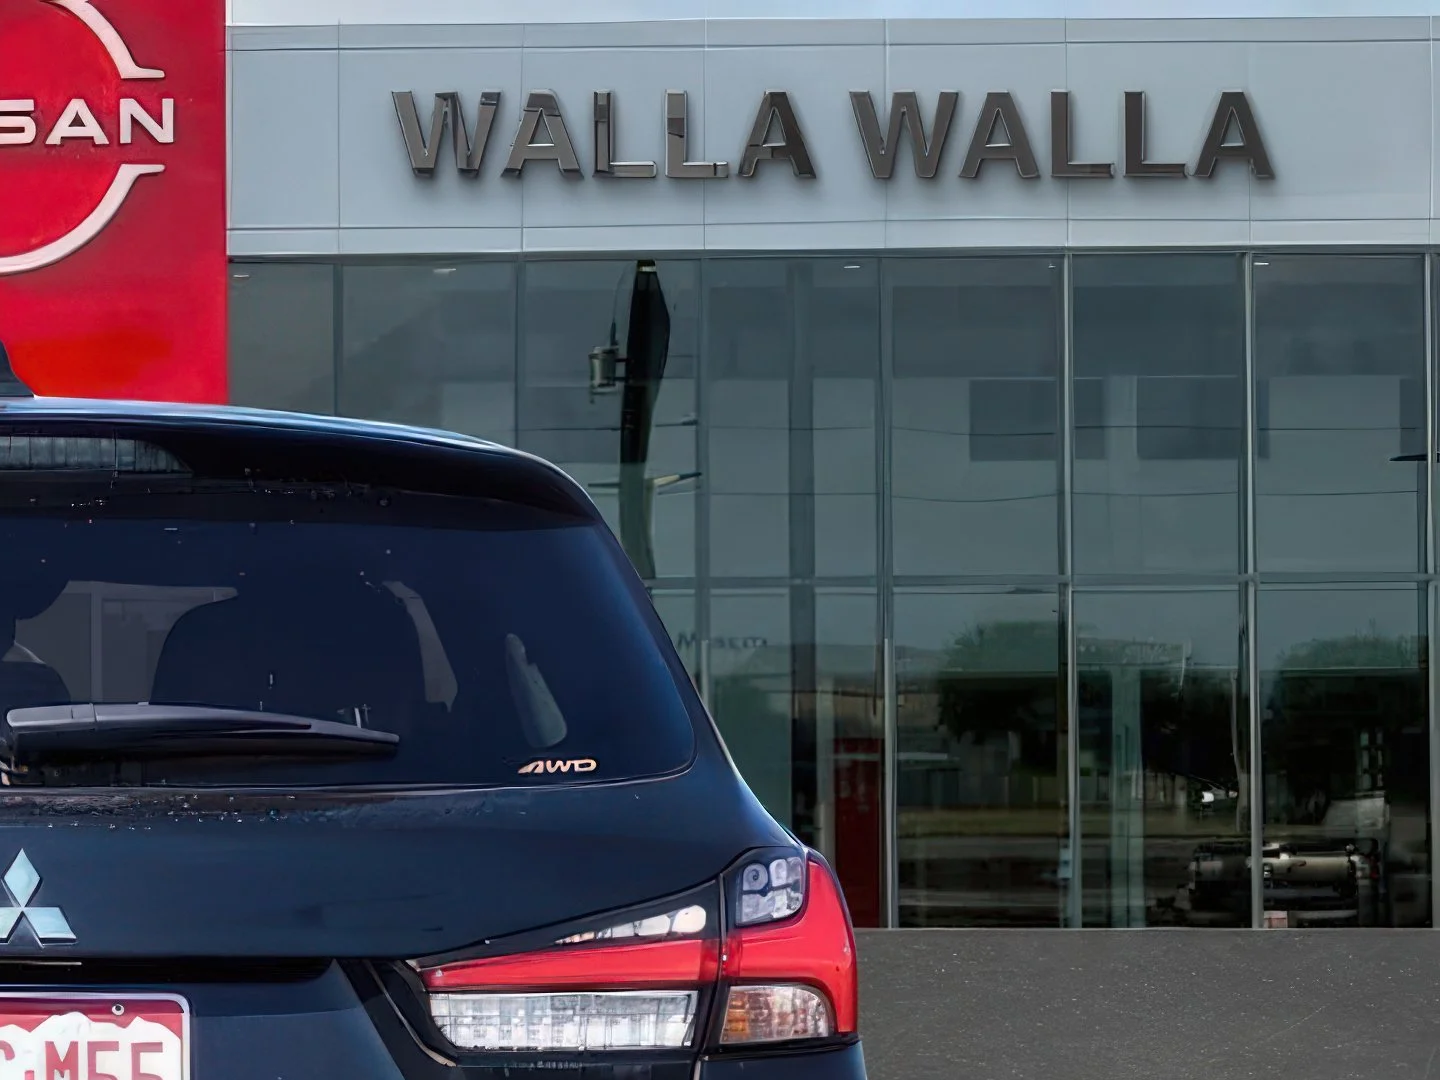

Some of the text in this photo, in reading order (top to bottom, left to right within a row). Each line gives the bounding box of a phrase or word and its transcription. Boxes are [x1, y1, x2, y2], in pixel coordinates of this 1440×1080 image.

[391, 89, 1275, 179] WALLA WALLA
[518, 759, 597, 773] AWD
